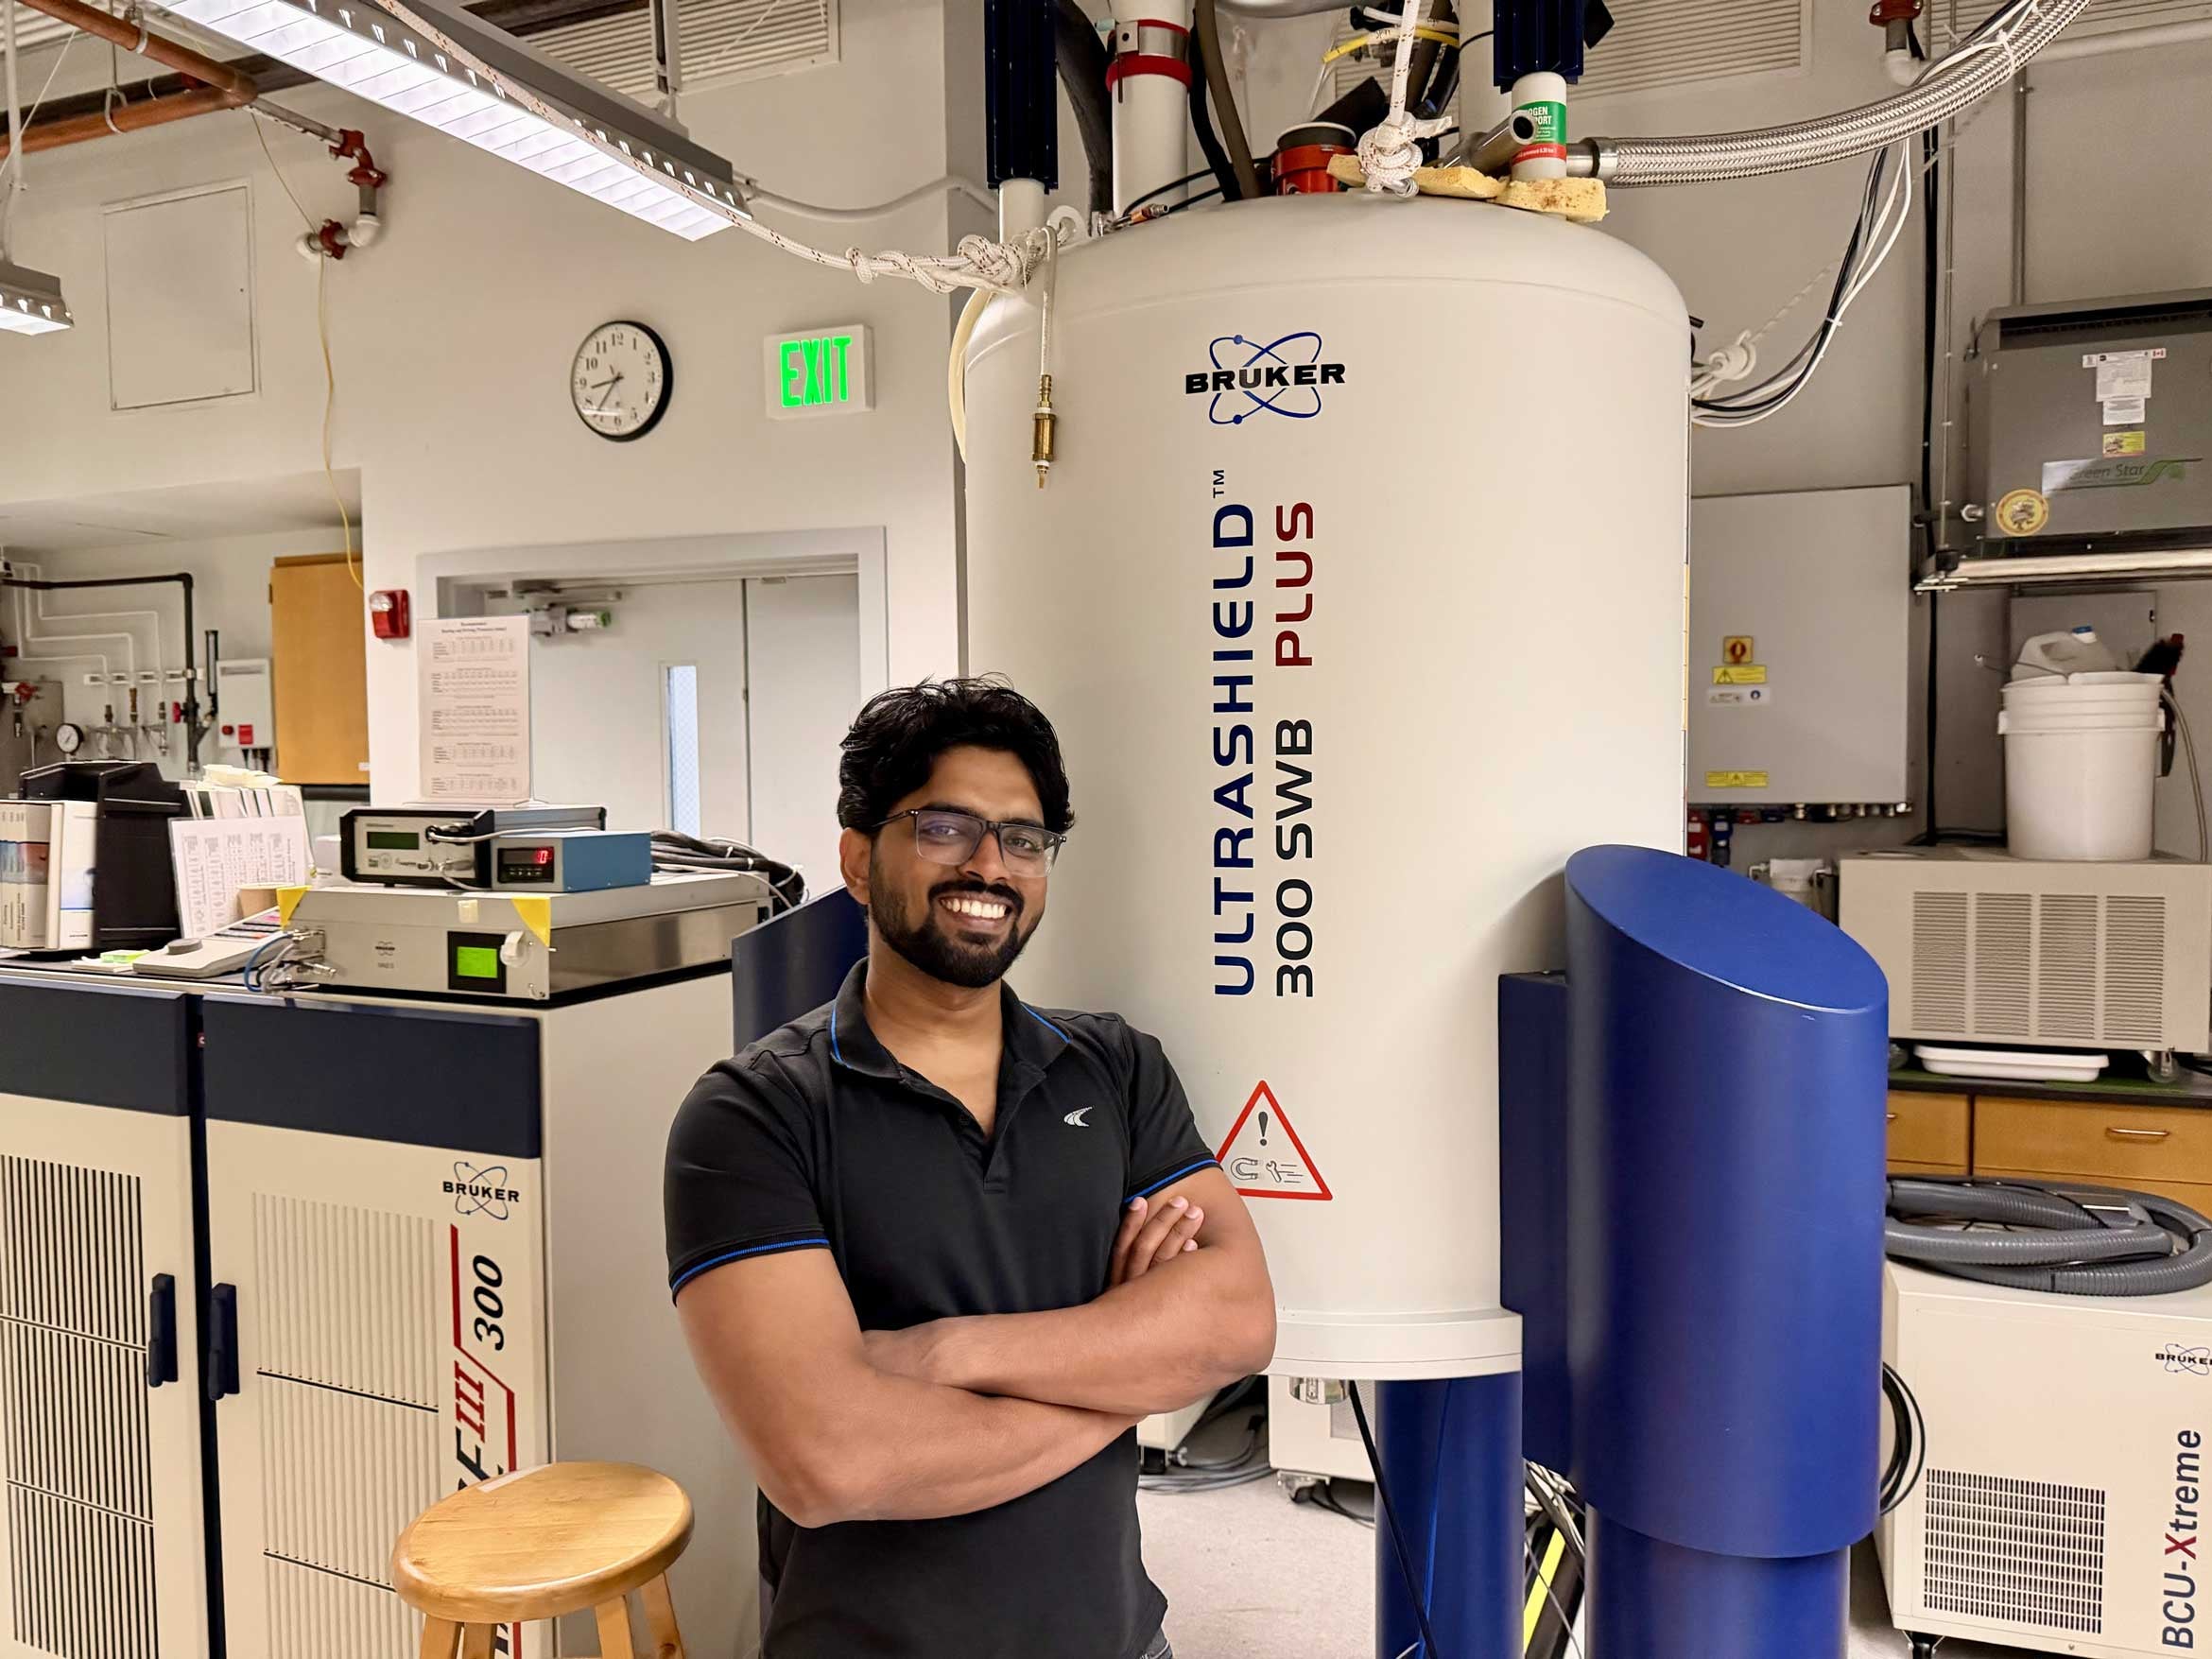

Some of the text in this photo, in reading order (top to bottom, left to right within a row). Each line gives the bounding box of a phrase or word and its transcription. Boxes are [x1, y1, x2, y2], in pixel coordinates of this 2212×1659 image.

[1528, 106, 1548, 116] OGEN
[1536, 115, 1551, 125] ORT
[596, 340, 608, 354] 11
[611, 333, 624, 346] 12
[631, 337, 638, 351] 1
[586, 357, 598, 371] 10
[780, 336, 853, 407] EXIT
[1185, 363, 1346, 394] BRUKER
[1275, 502, 1313, 997] 300 SWB PLUS
[442, 1181, 519, 1202] BRUKER
[473, 1254, 505, 1351] 300
[2162, 1429, 2202, 1649] BCU-Xtreme
